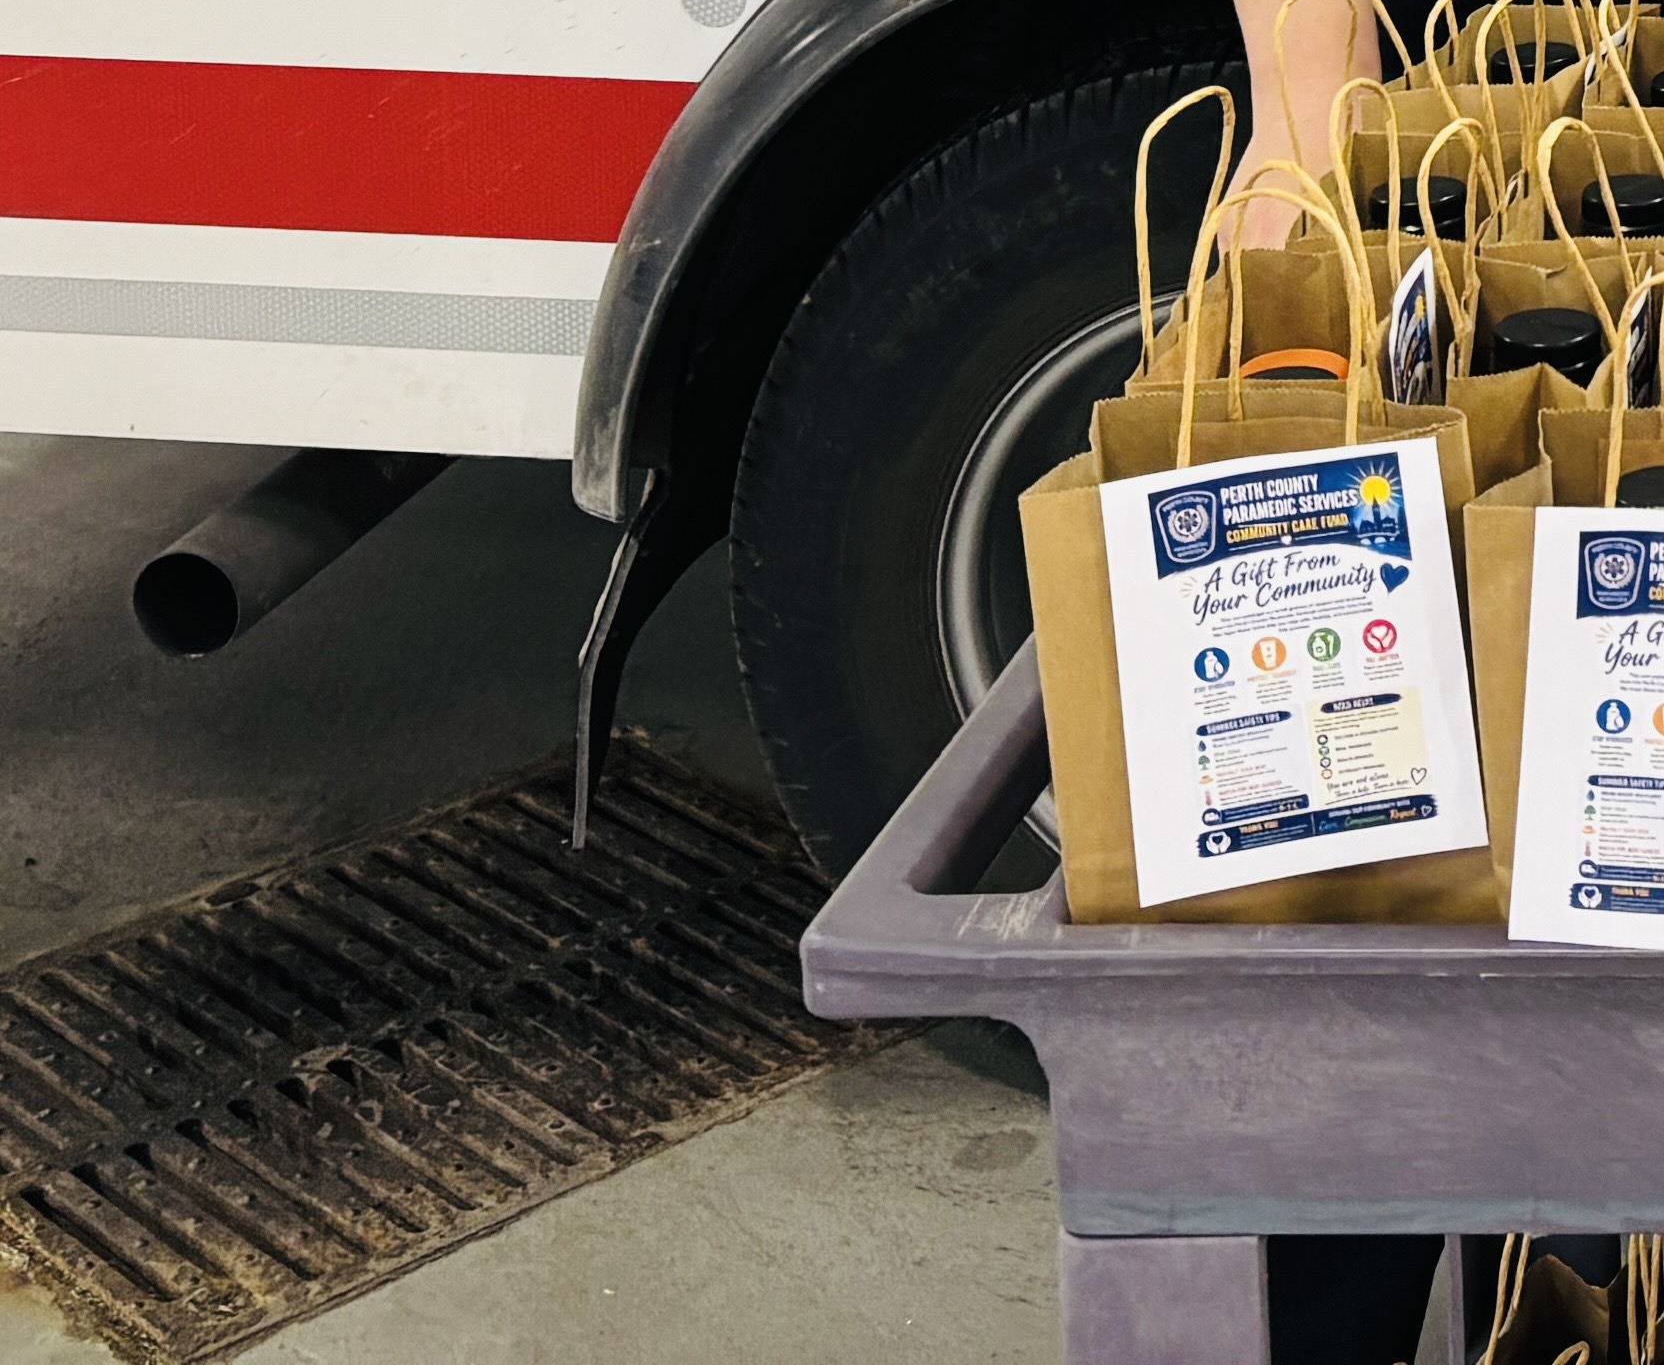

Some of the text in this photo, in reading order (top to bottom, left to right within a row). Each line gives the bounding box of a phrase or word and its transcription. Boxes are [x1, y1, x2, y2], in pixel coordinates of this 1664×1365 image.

[1221, 474, 1318, 505] PERTH COUNTY
[1223, 489, 1359, 526] PARAMEDIC SERVICES
[1205, 551, 1341, 593] A Gift From
[1194, 594, 1249, 626] Your
[1256, 562, 1377, 607] Community
[1619, 620, 1639, 646] A
[1605, 643, 1659, 674] Your
